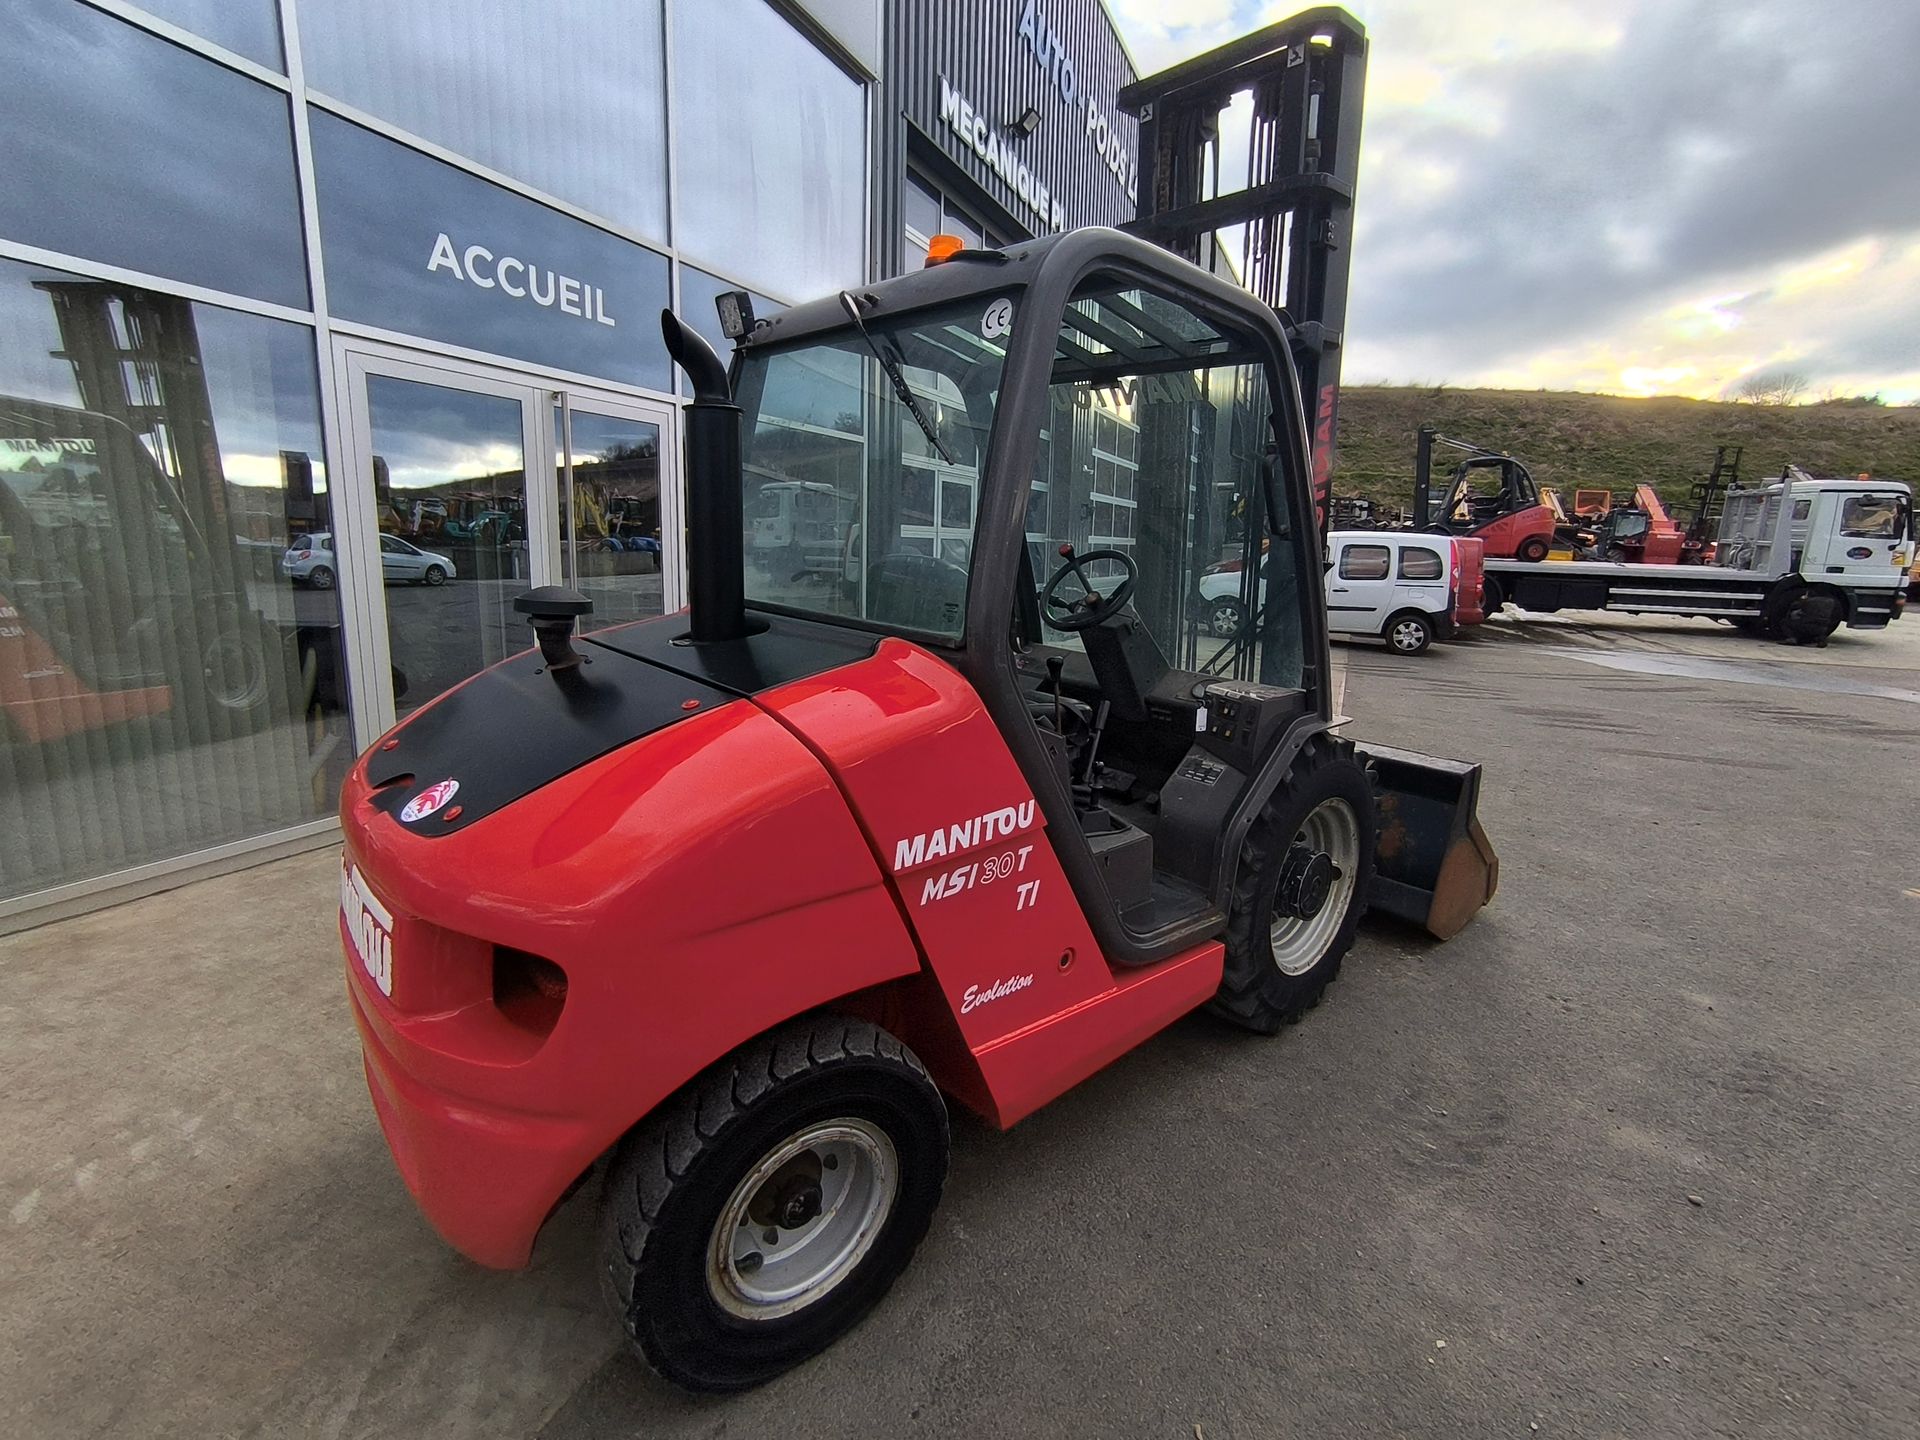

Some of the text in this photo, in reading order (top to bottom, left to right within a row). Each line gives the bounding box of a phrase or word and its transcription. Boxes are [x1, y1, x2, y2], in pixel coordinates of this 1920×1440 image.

[1018, 0, 1075, 104] AUTO
[1086, 97, 1127, 187] POIDS
[938, 76, 1049, 223] MECANIQUE
[427, 232, 615, 326] ACCUEIL
[985, 306, 1009, 330] CE
[894, 799, 1035, 871] MANITOU
[1016, 880, 1041, 911] TI
[961, 973, 1034, 1014] Evolution
